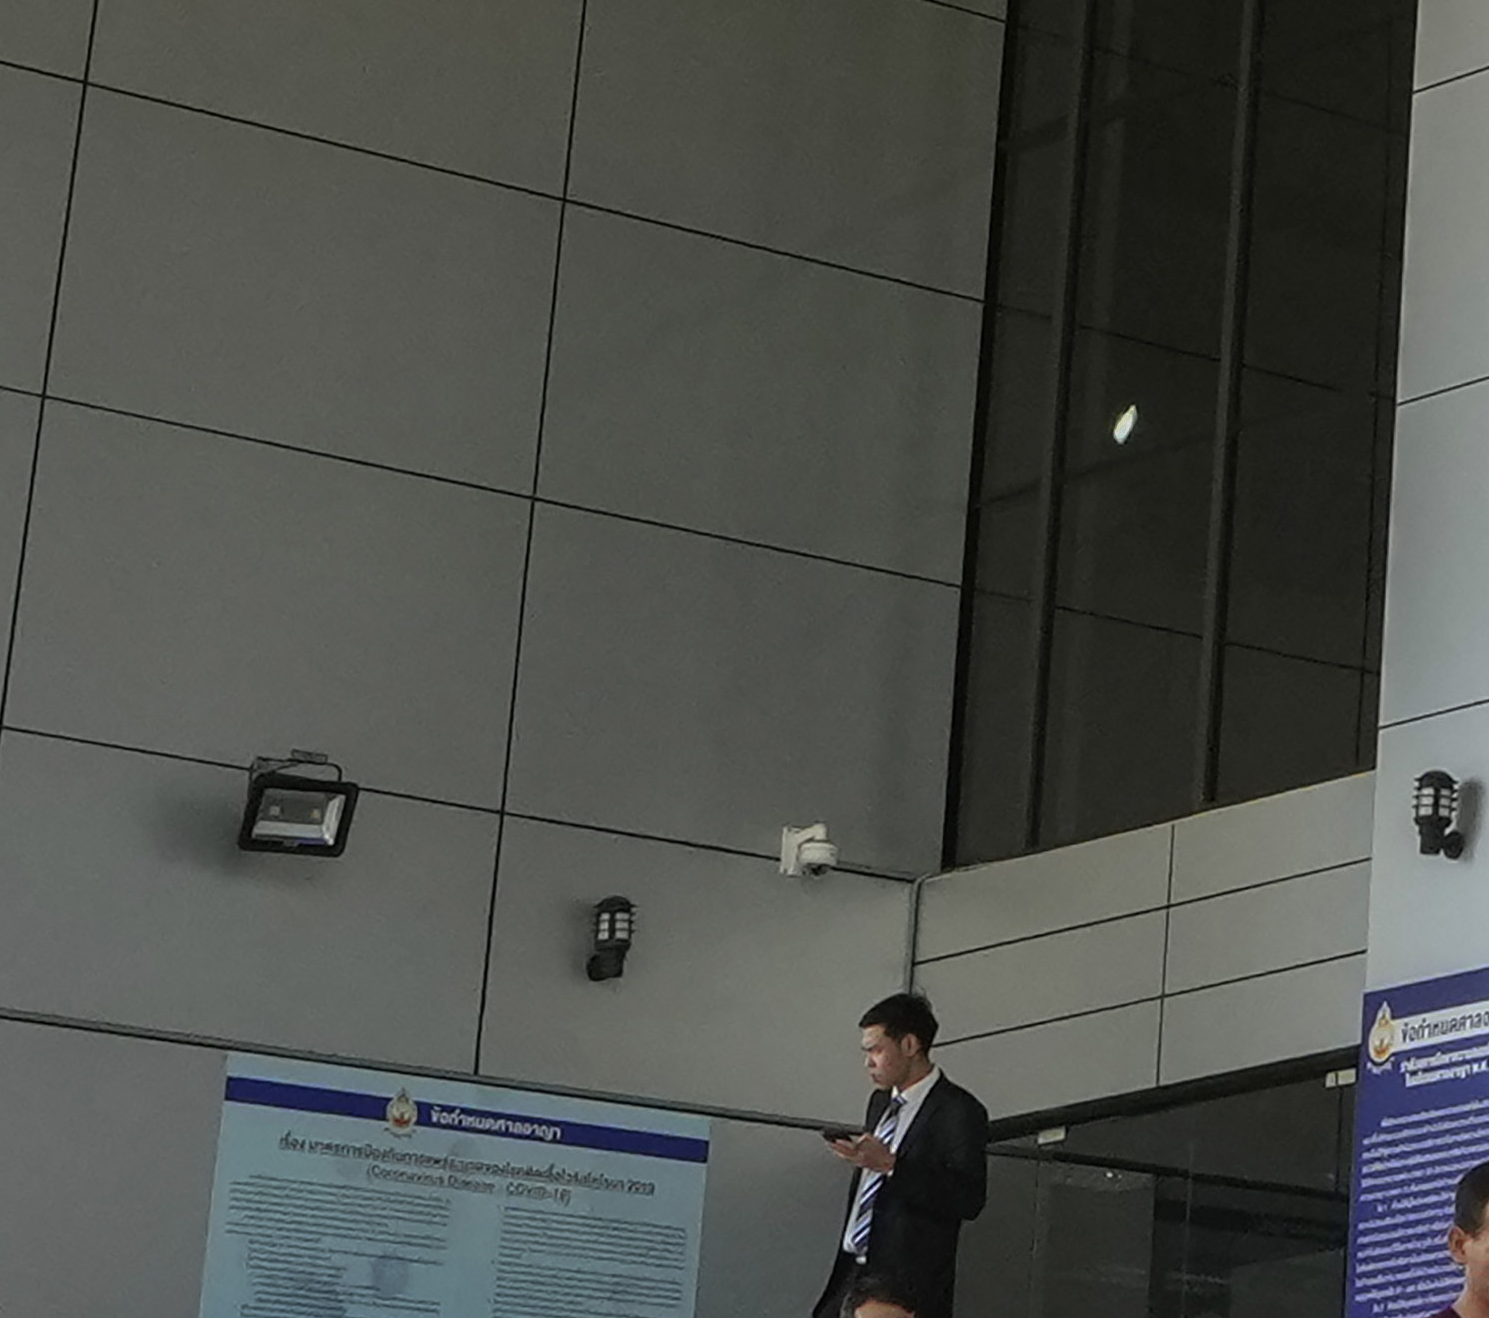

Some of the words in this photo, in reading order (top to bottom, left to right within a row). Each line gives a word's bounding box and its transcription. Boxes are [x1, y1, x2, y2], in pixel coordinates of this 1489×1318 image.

[429, 1106, 562, 1141] ข้อกำหนดศาลอาญา
